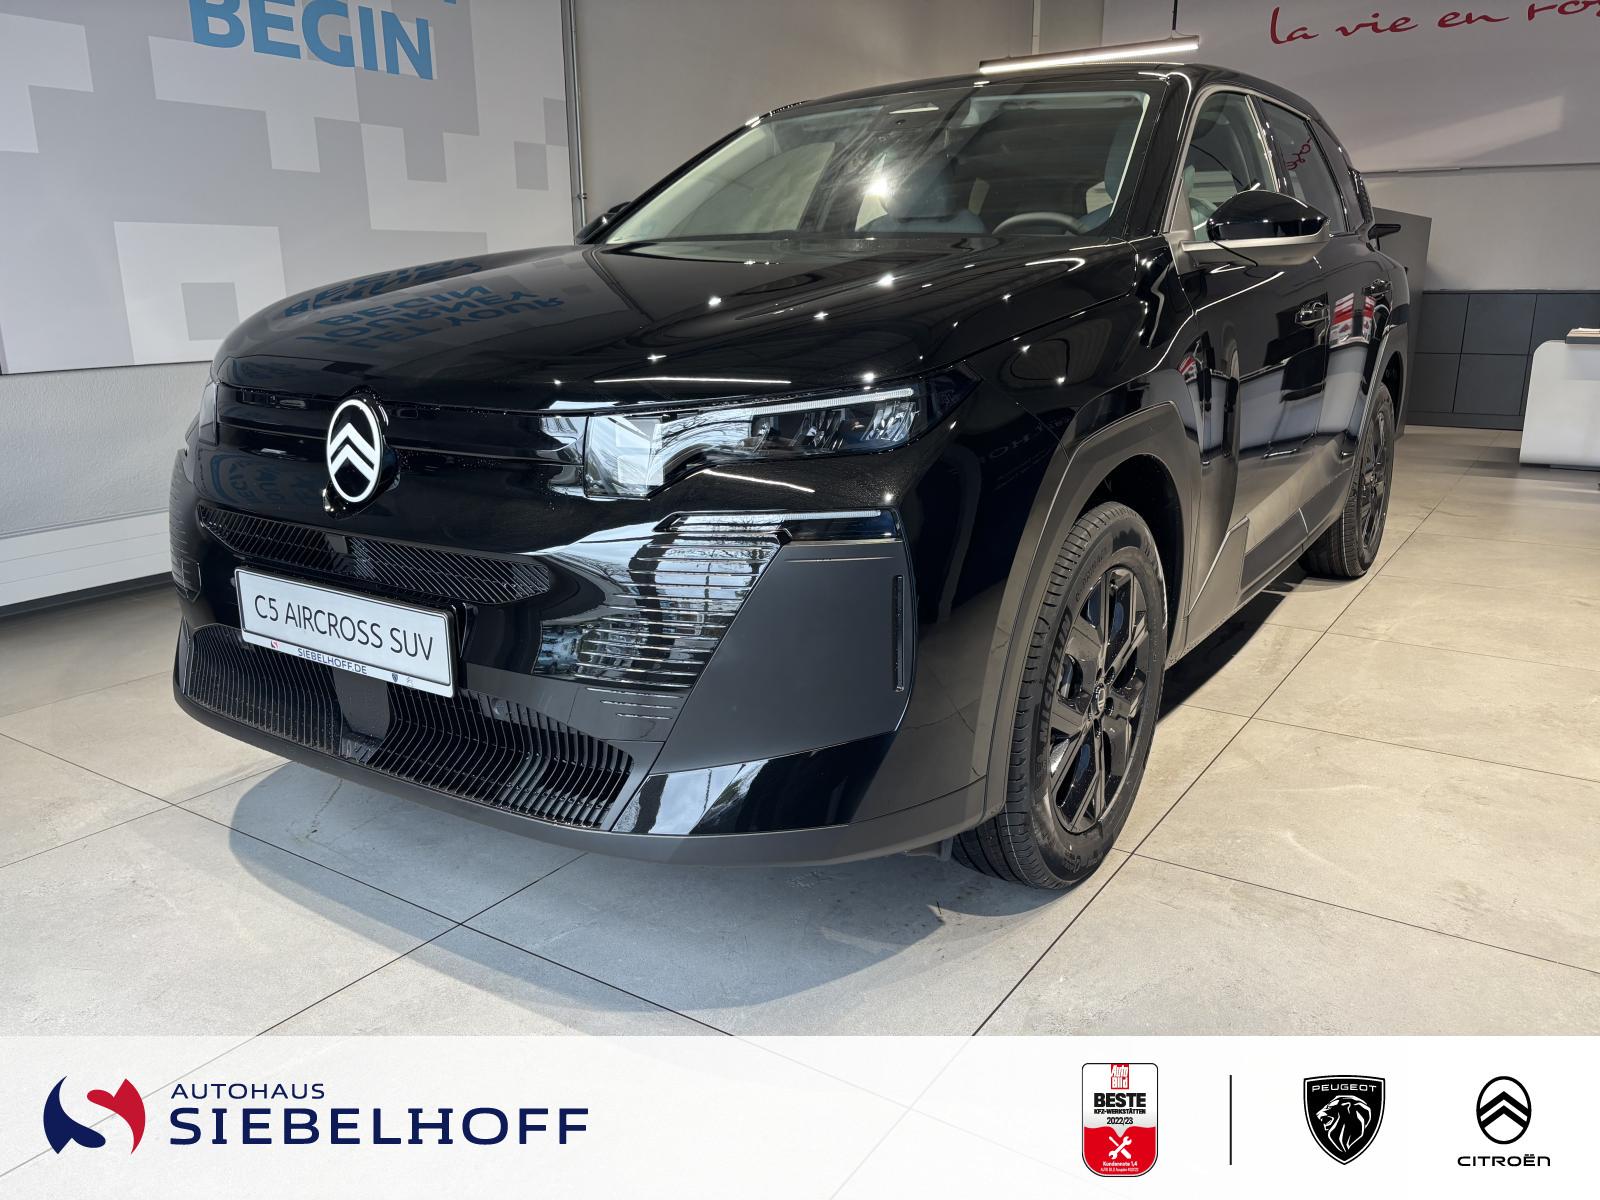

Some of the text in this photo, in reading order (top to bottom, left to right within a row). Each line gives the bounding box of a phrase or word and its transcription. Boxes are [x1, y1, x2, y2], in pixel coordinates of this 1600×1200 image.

[188, 0, 433, 80] BEGIN
[1335, 13, 1418, 36] vie
[1437, 11, 1509, 28] en
[1528, 0, 1600, 21] ro
[254, 595, 433, 661] C5 AIRCROSS SUV
[297, 647, 367, 675] SIEBELHOFF.DE
